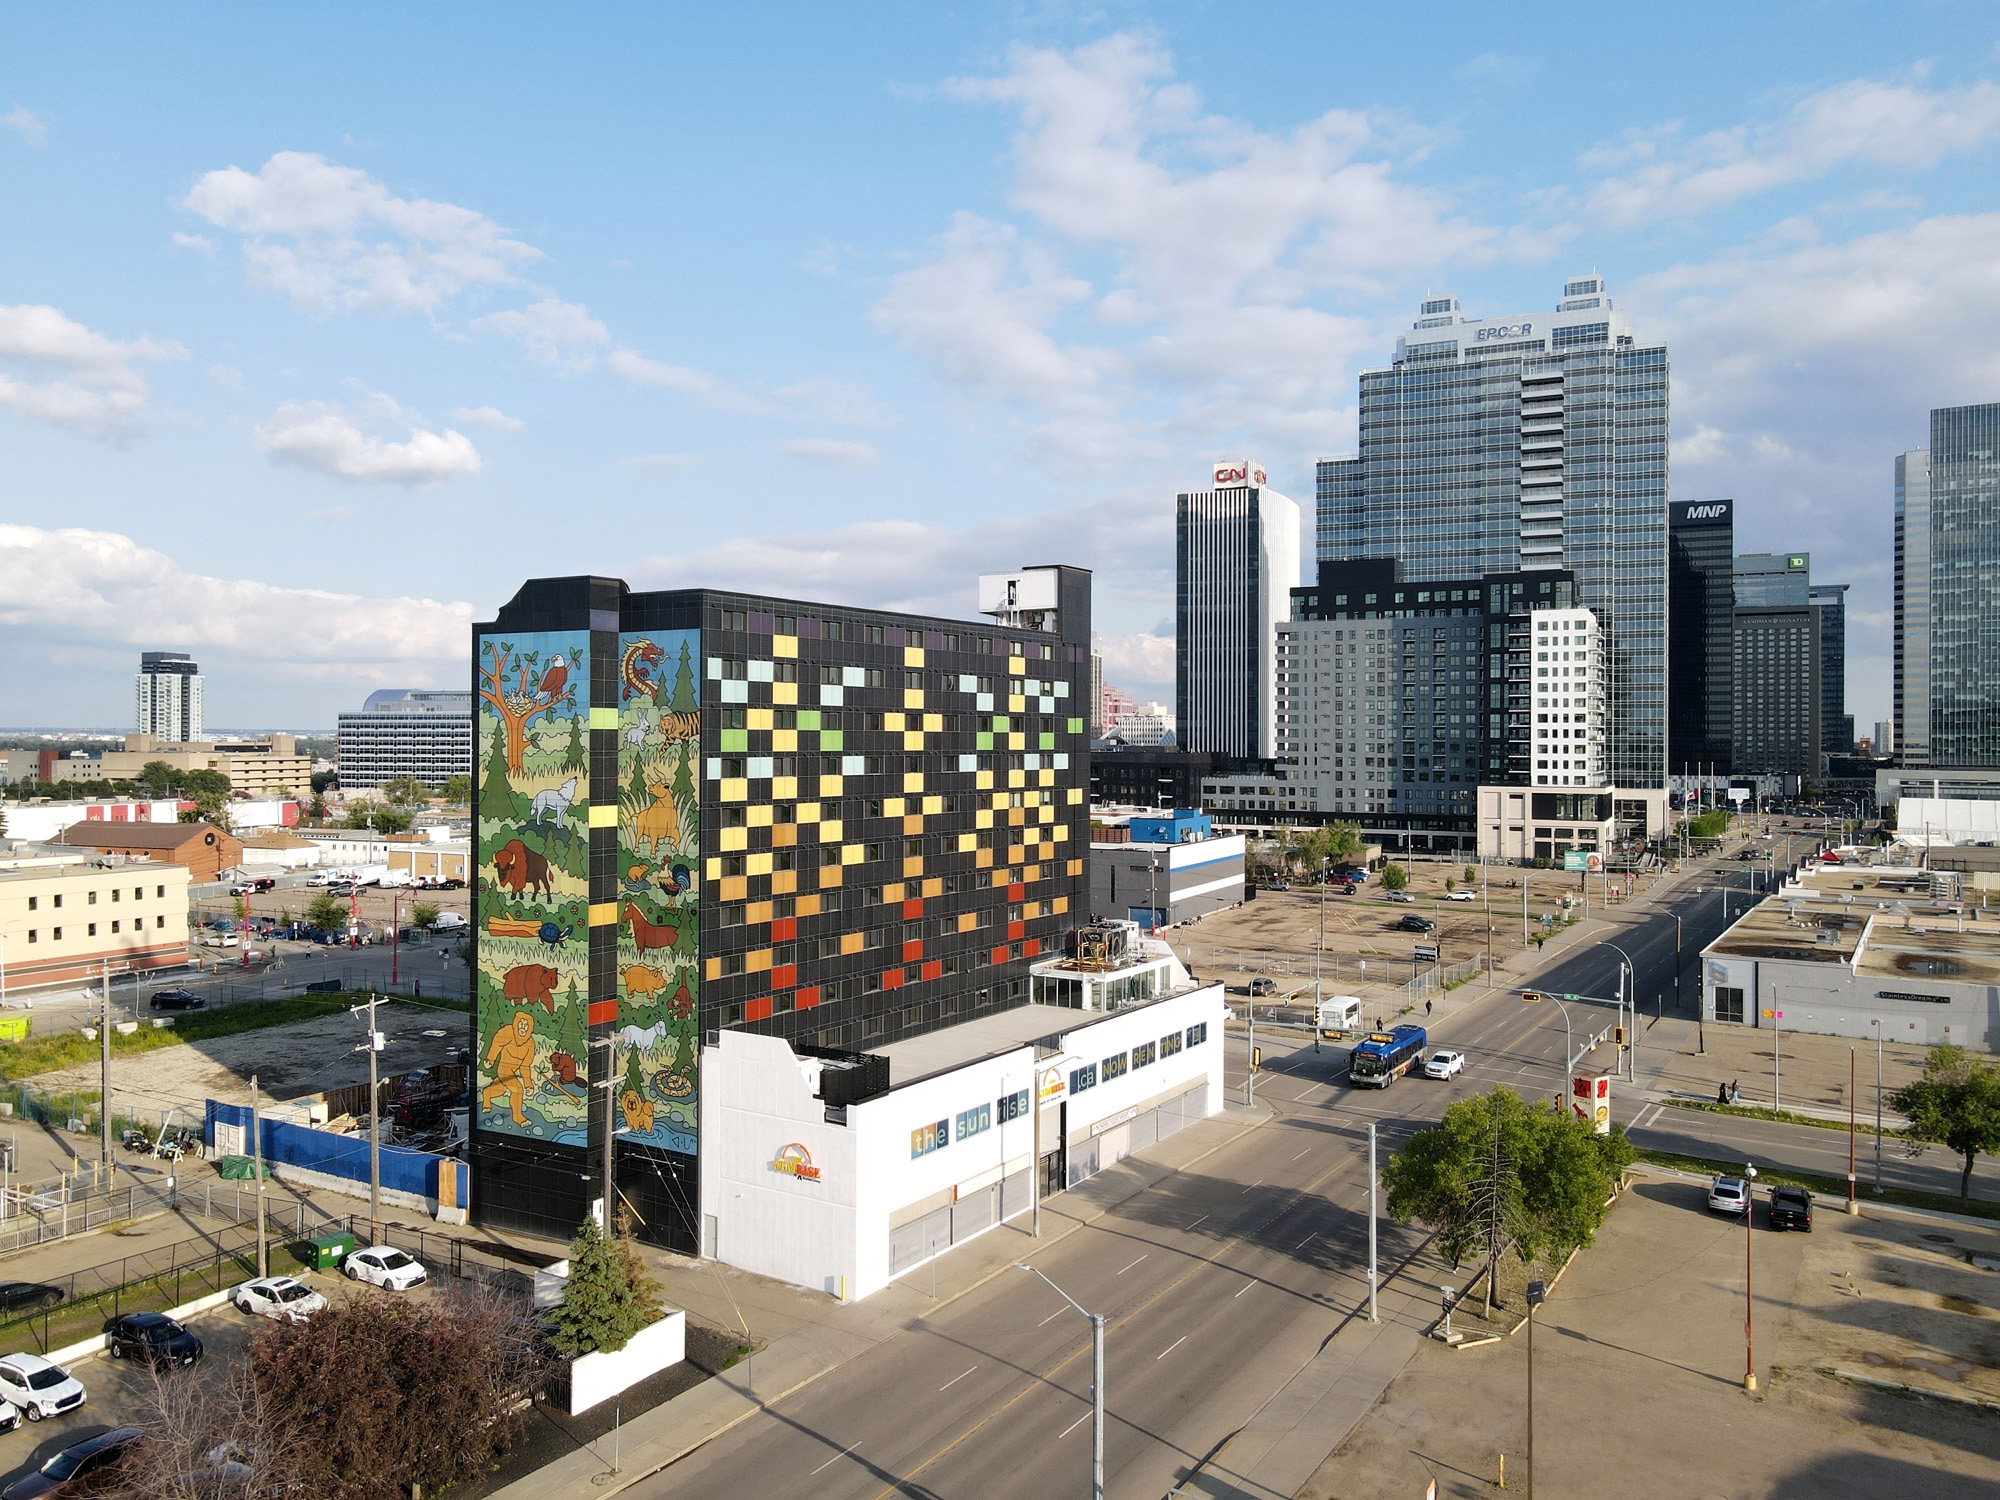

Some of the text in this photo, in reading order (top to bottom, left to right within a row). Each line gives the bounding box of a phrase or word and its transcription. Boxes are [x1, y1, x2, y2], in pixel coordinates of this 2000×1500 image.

[1477, 323, 1532, 340] EPCOR
[1216, 468, 1246, 481] CN
[1686, 504, 1727, 519] MNP
[915, 1128, 945, 1153] the
[1103, 1056, 1127, 1077] NOW
